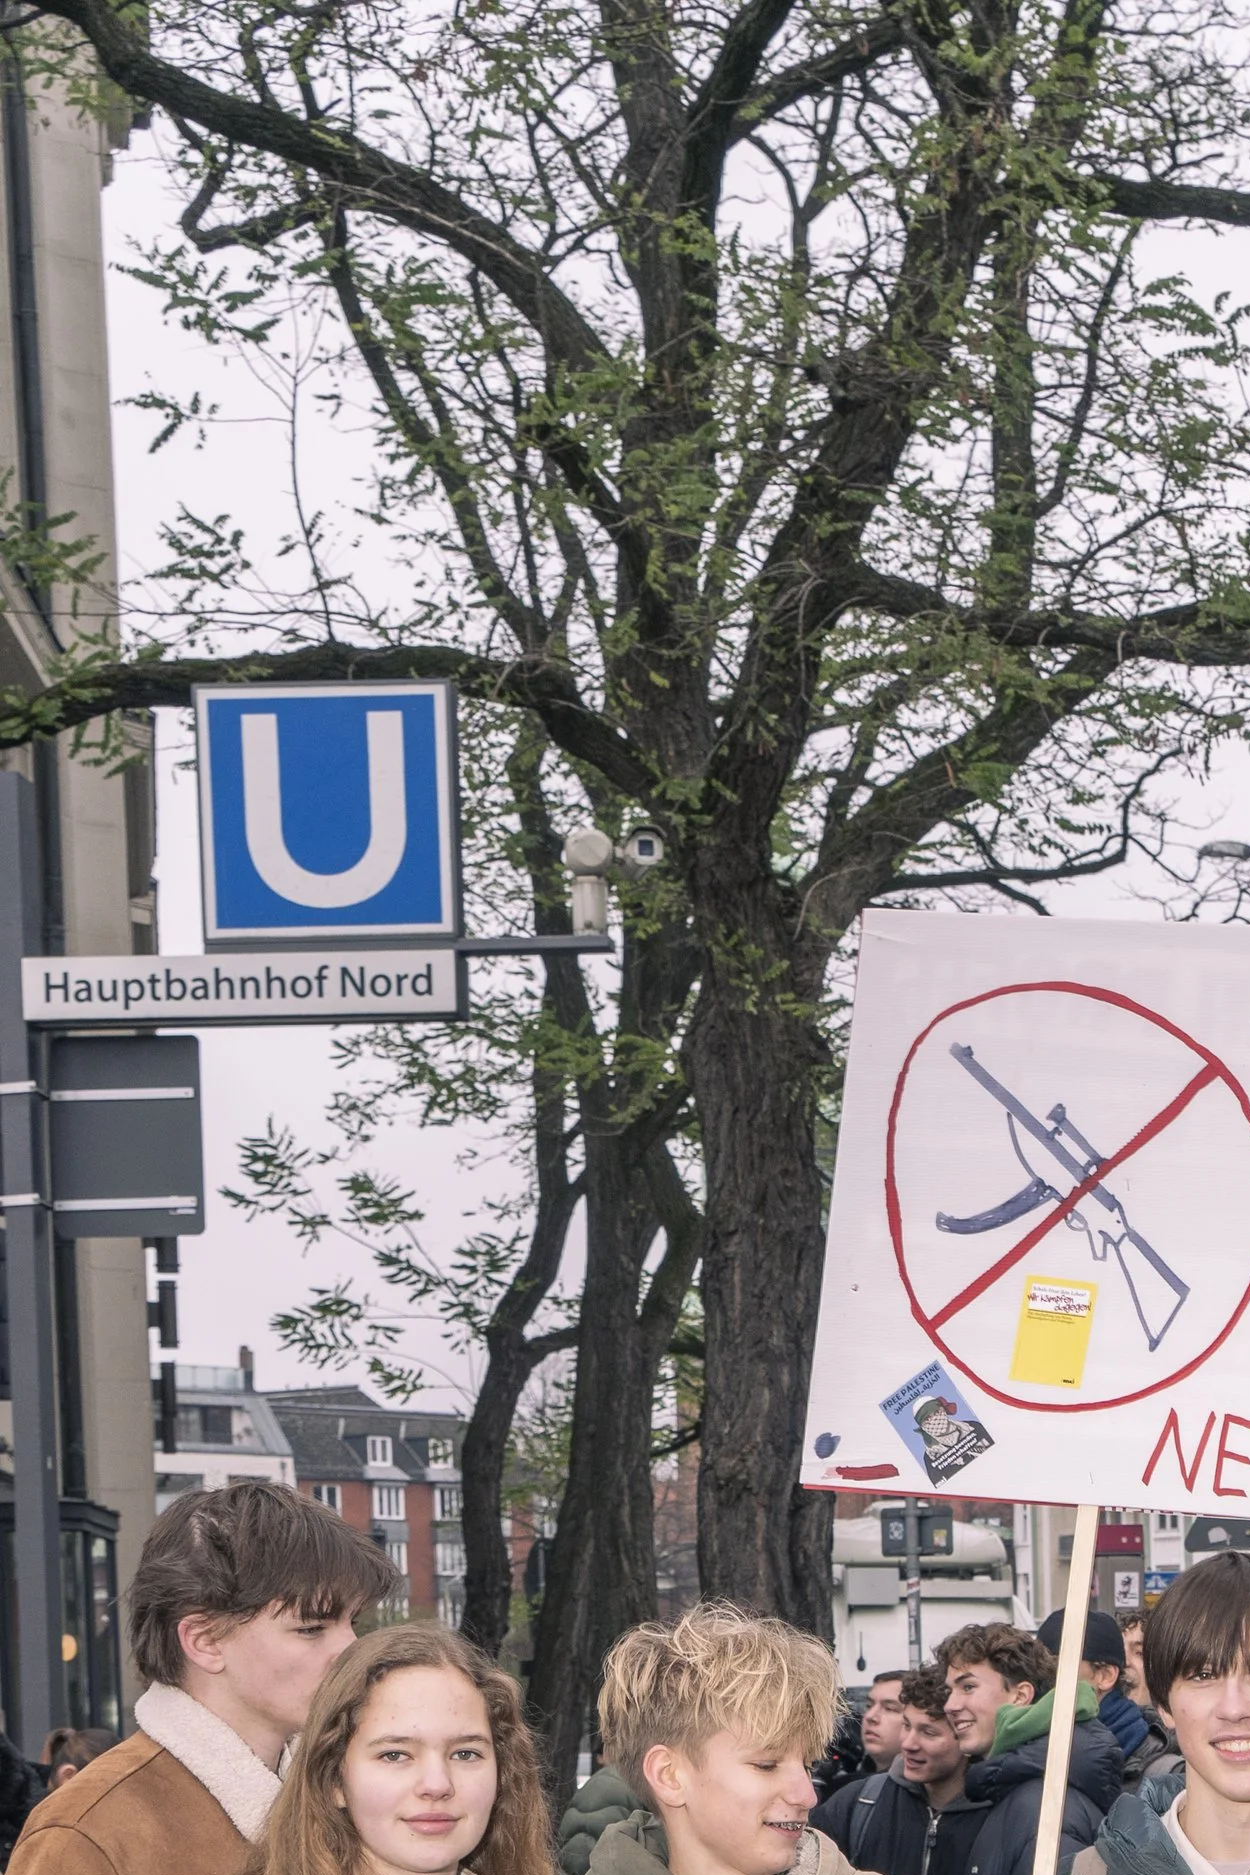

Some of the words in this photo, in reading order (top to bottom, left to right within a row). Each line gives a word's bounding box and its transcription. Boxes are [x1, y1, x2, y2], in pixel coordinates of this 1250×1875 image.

[240, 710, 407, 908] U
[43, 964, 330, 1010] Hauptbahnhof
[340, 963, 433, 998] Nord
[882, 1394, 902, 1411] FREE
[901, 1363, 941, 1397] PALESTINE
